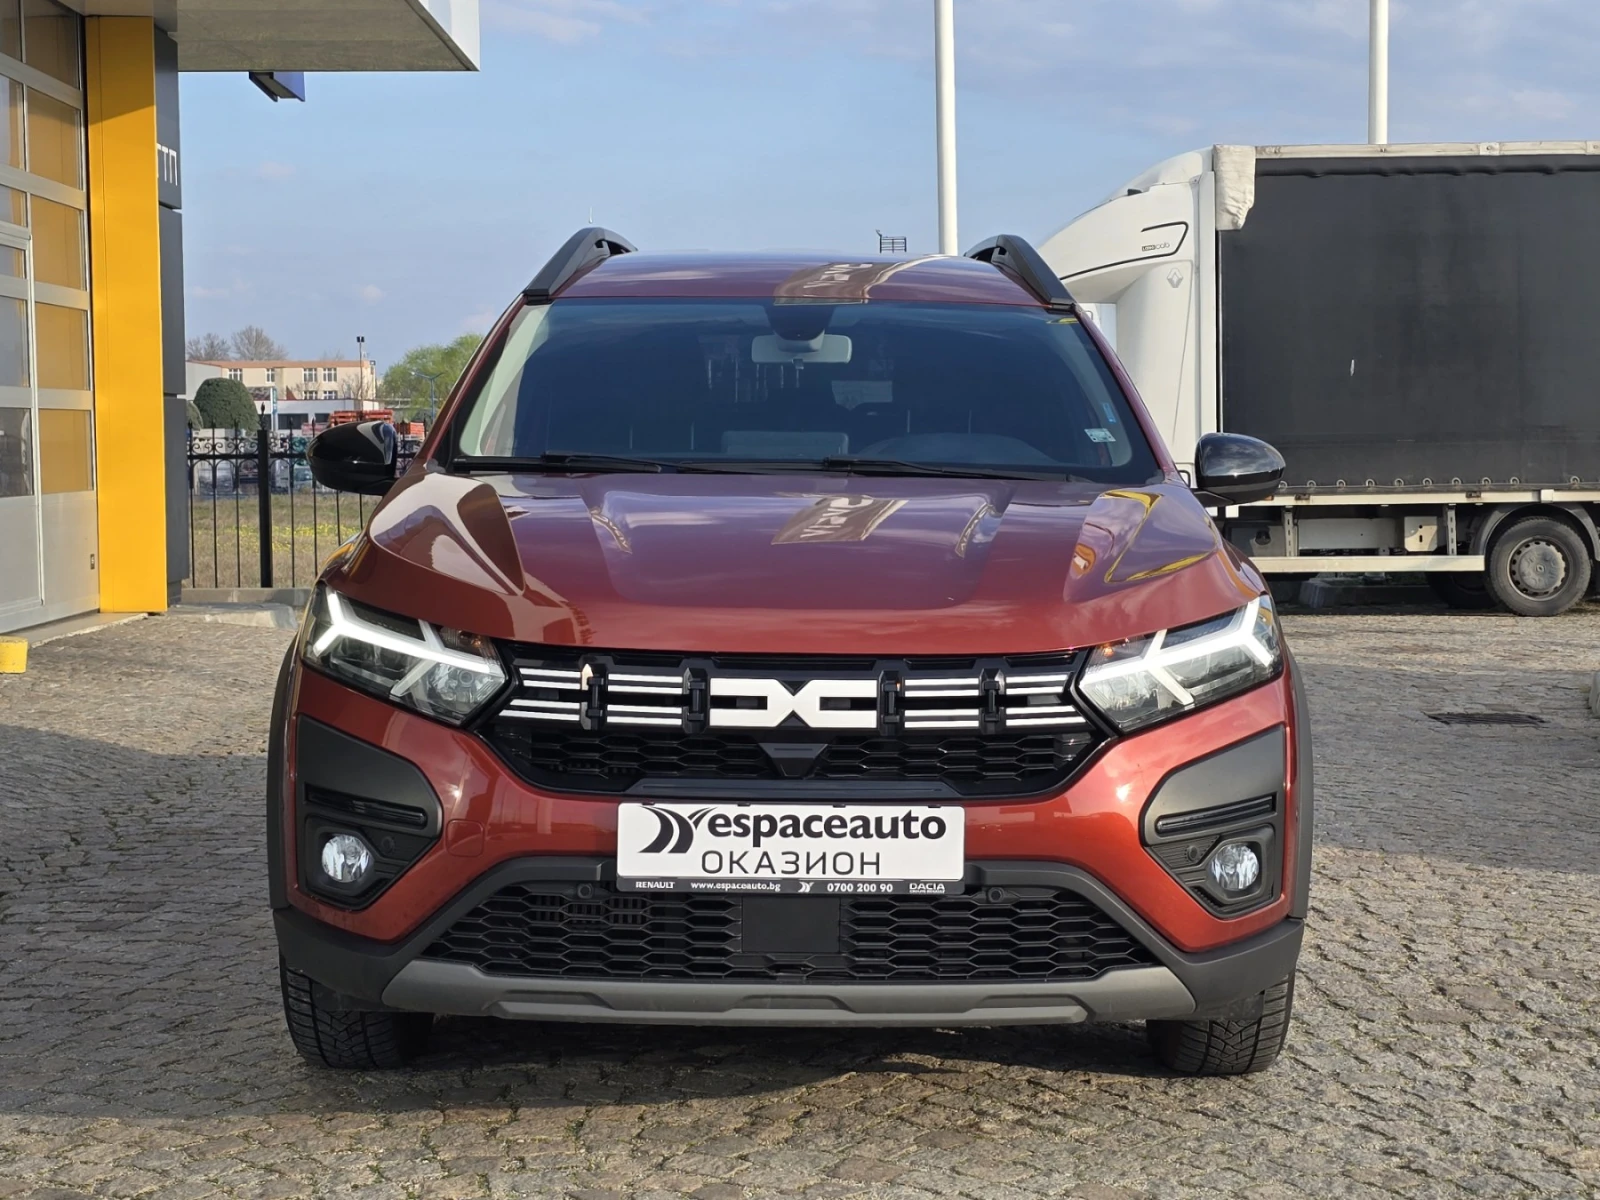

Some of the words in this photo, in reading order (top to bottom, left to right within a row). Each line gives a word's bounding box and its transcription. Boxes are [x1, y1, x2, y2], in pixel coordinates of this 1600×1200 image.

[707, 809, 947, 848] espaceauto
[701, 850, 880, 876] ОКАЗИОН
[635, 881, 676, 889] RENAULT
[690, 881, 781, 893] www.espaceauto.bg
[827, 882, 854, 893] 0700
[856, 882, 879, 893] 200
[879, 883, 894, 894] 90
[909, 882, 945, 891] DACIA
